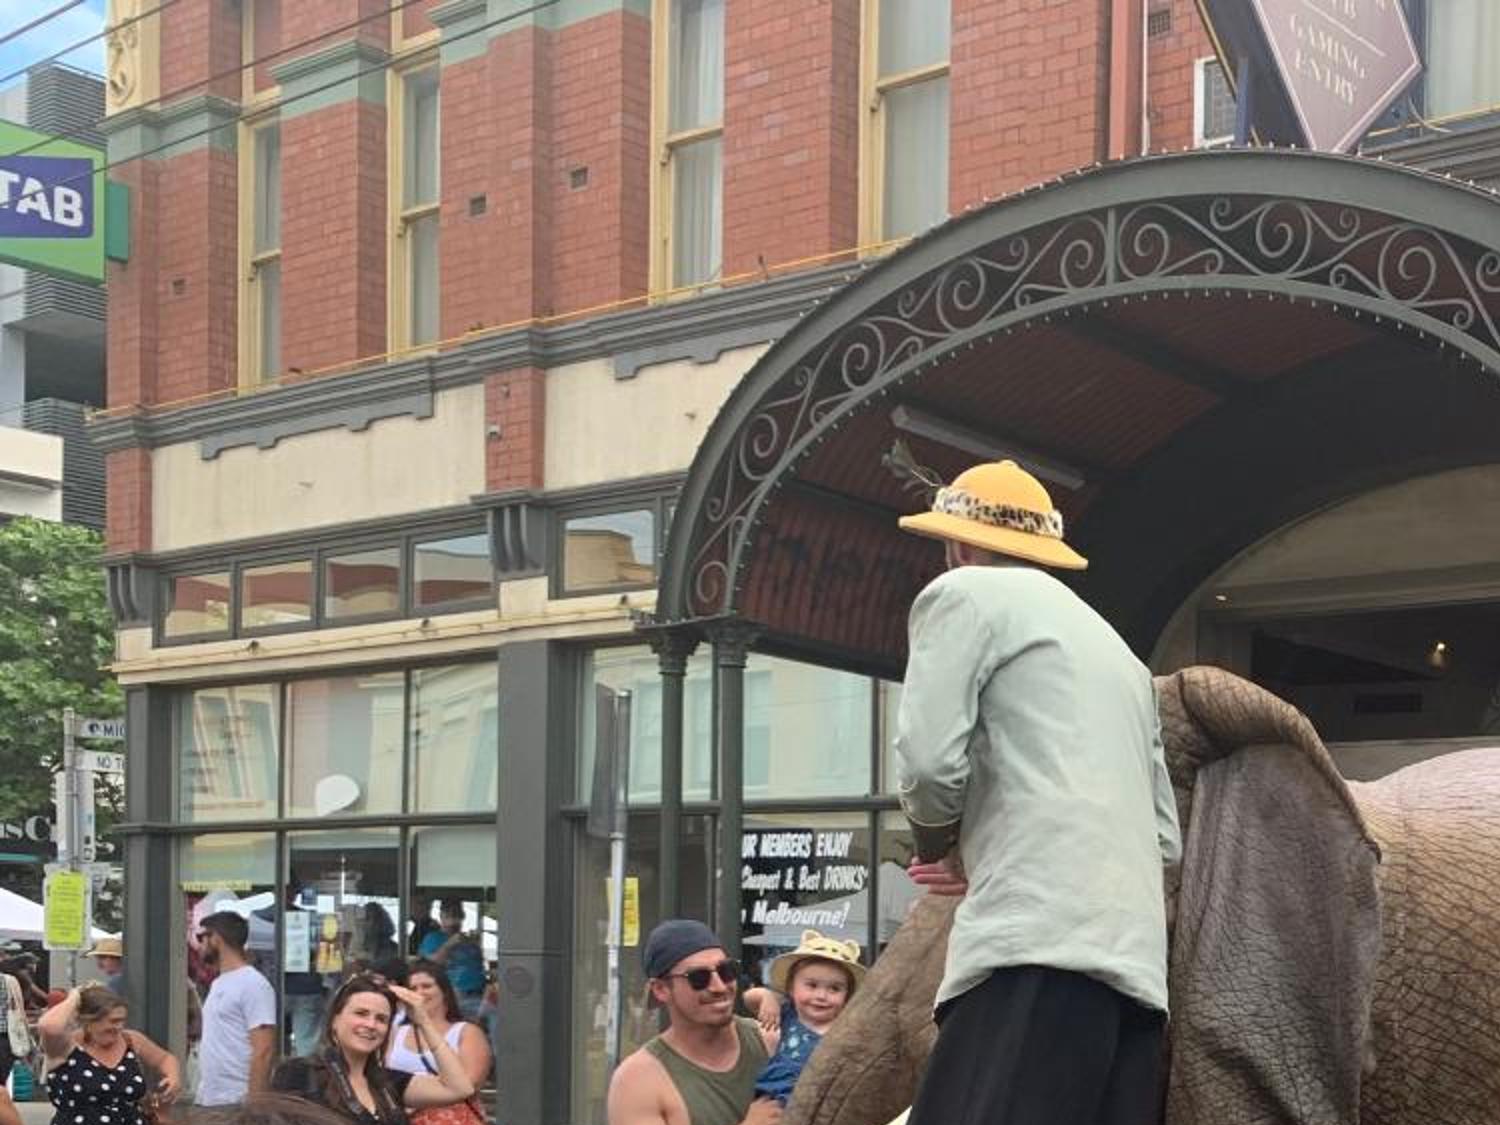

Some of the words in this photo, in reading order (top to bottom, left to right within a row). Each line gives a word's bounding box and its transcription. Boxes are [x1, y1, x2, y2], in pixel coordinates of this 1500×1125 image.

[0, 169, 84, 227] TAB
[741, 833, 758, 858] UR
[760, 832, 813, 858] MEMBERS
[815, 831, 854, 857] ENJOY
[783, 866, 795, 890] &
[798, 864, 821, 890] Best
[751, 900, 851, 929] Melbourne!
